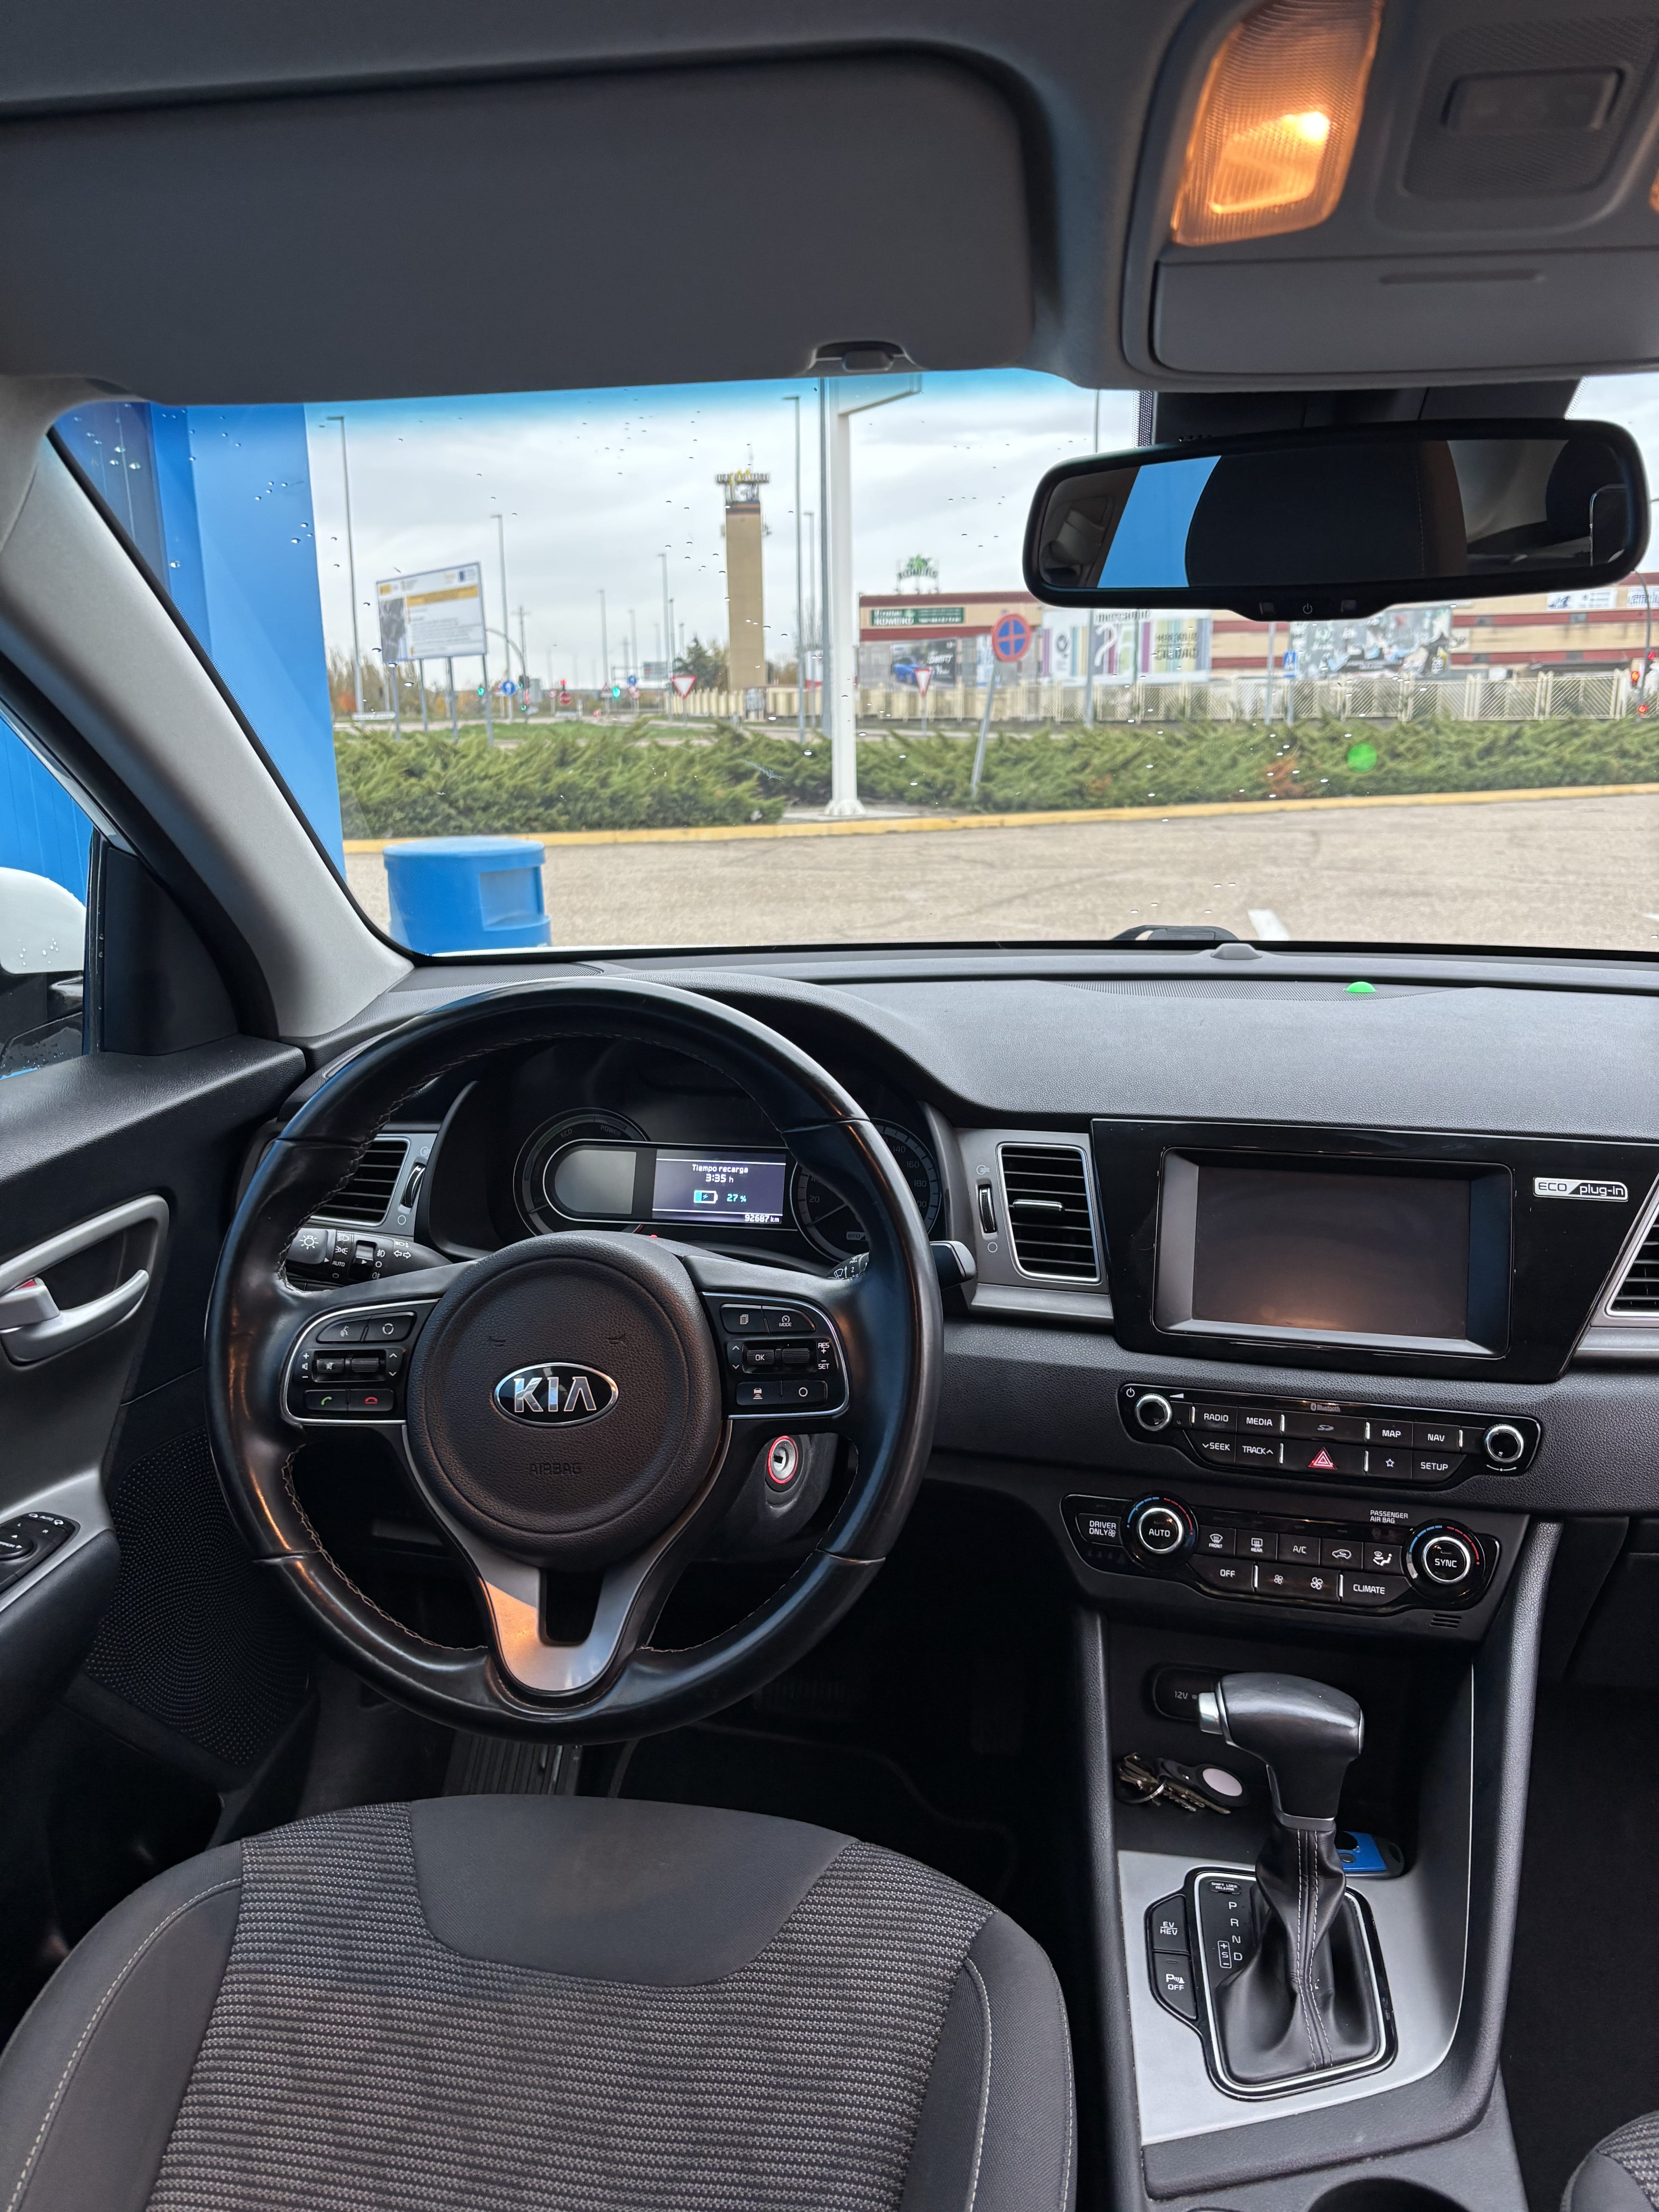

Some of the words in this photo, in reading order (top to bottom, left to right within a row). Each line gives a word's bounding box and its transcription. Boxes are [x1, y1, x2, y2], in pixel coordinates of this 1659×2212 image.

[561, 1128, 573, 1138] ECO
[600, 1125, 621, 1137] POWER
[705, 1173, 726, 1183] 3:35
[1539, 1182, 1567, 1191] ECO
[1580, 1184, 1623, 1197] plug-in
[726, 1194, 738, 1202] 27
[744, 1214, 770, 1223] 92687
[514, 1376, 596, 1412] KIA
[1204, 1413, 1228, 1422] RADIO
[1246, 1417, 1273, 1426] MEDIA
[1382, 1429, 1401, 1437] MAP
[1427, 1434, 1445, 1442] NAV
[1209, 1442, 1230, 1451] SEEK
[1242, 1446, 1266, 1454] TRACK
[1420, 1462, 1448, 1471] SETUP
[1370, 1510, 1408, 1519] PASSENGER
[1089, 1520, 1116, 1529] DRIVER
[1149, 1528, 1170, 1537] AUTO
[1293, 1545, 1306, 1554] A/C
[1435, 1558, 1457, 1568] SYNC
[1220, 1569, 1235, 1577] OFF
[1353, 1584, 1385, 1594] CLIMATE
[1175, 1691, 1188, 1699] 12V
[1228, 1901, 1237, 1910] P
[1230, 1918, 1239, 1927] R
[1232, 1935, 1241, 1944] N
[1233, 1952, 1243, 1961] D
[1166, 1973, 1174, 1982] P
